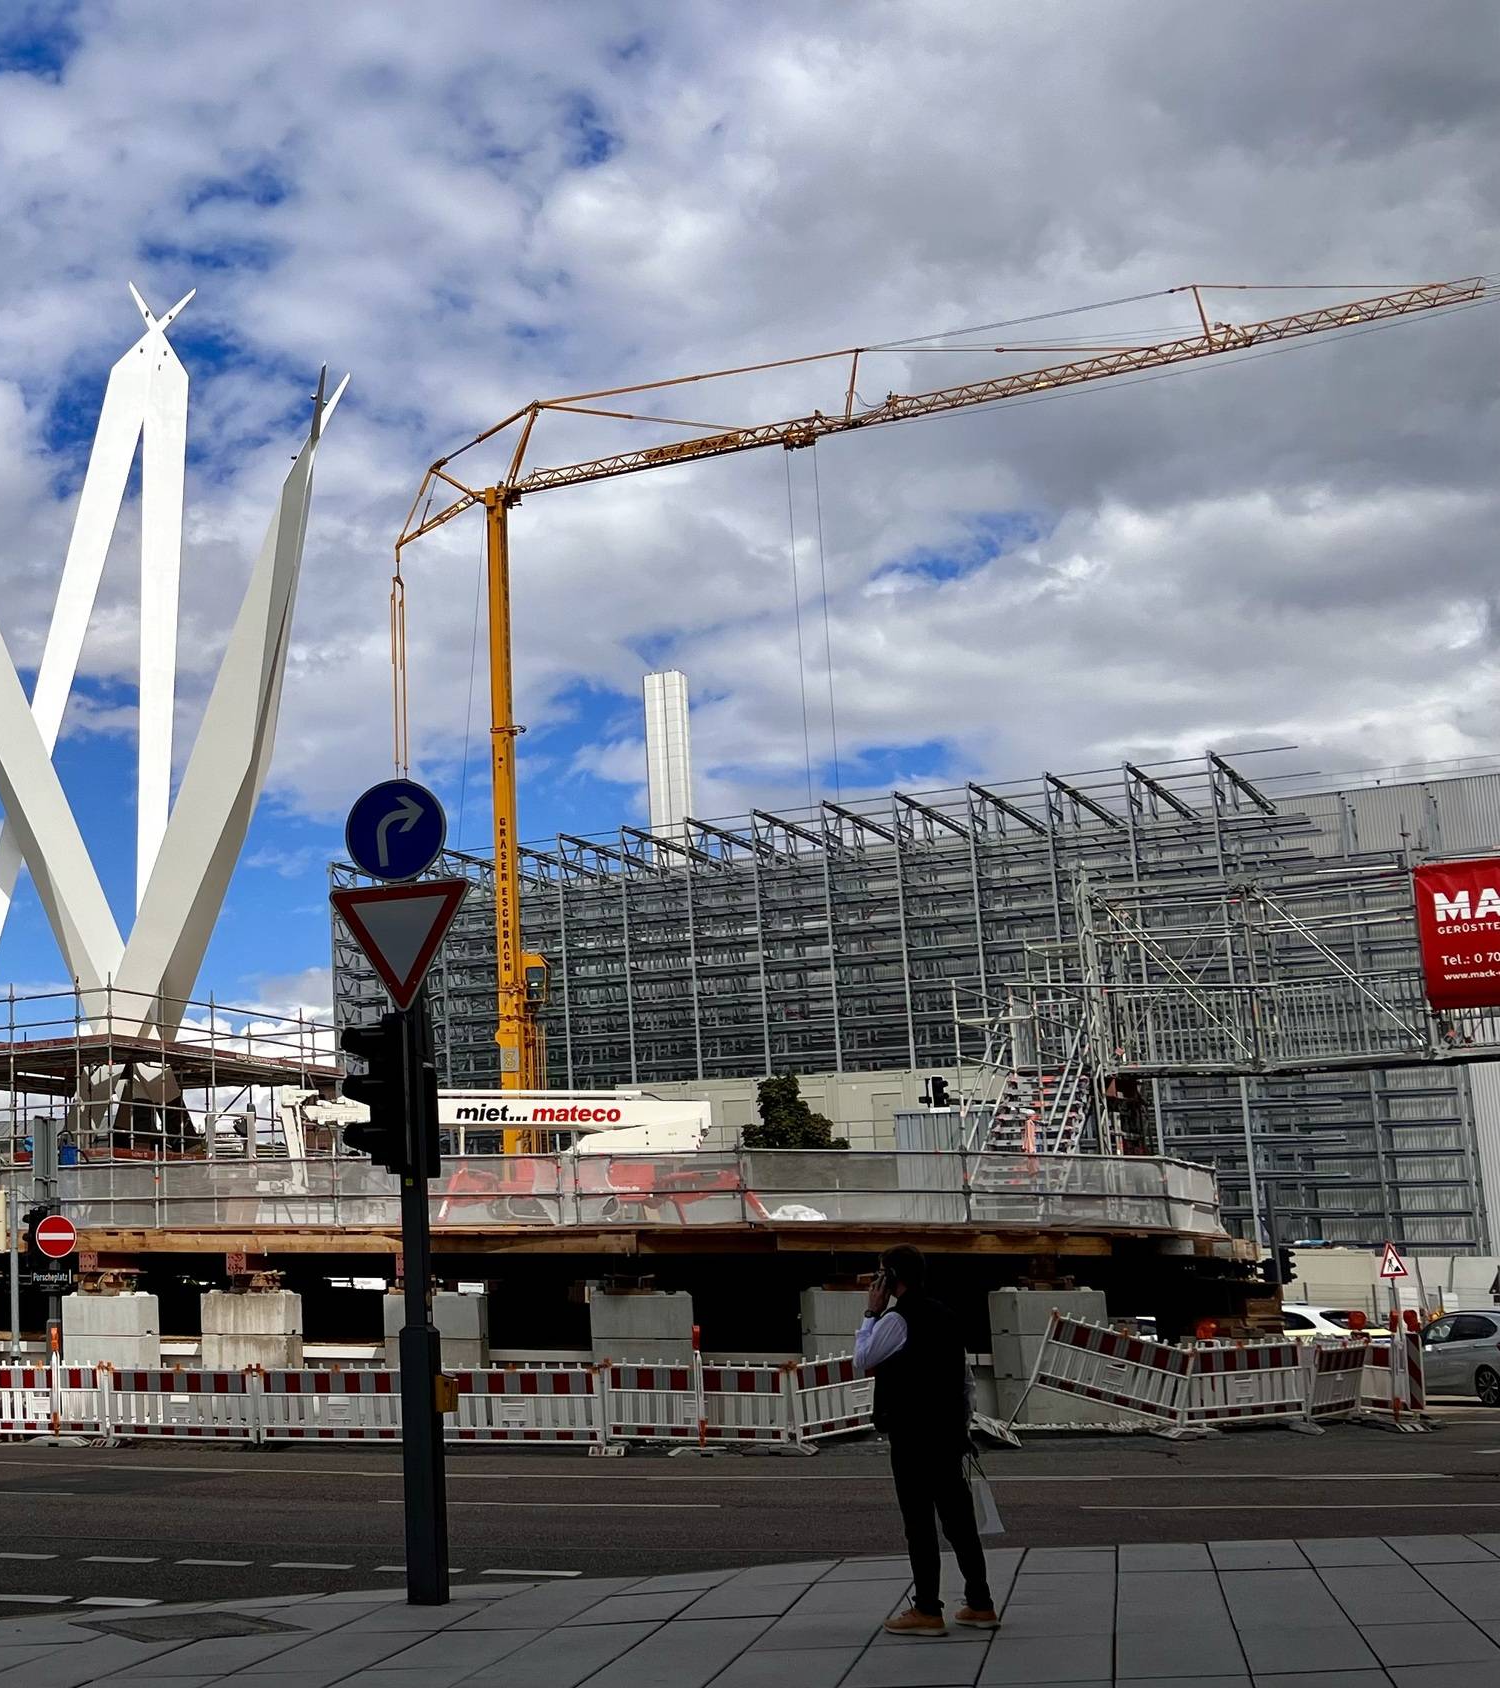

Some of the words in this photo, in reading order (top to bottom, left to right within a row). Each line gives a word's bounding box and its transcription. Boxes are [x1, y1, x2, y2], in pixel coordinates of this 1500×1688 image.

[499, 817, 509, 881] GRÄSER
[501, 887, 511, 972] ESCHBACH
[1441, 953, 1471, 966] Tel.:
[1473, 952, 1483, 964] 0
[1444, 969, 1500, 980] www.mack-
[456, 1103, 528, 1122] miet...
[532, 1105, 621, 1122] mateco
[32, 1271, 68, 1284] Porscheplatz
